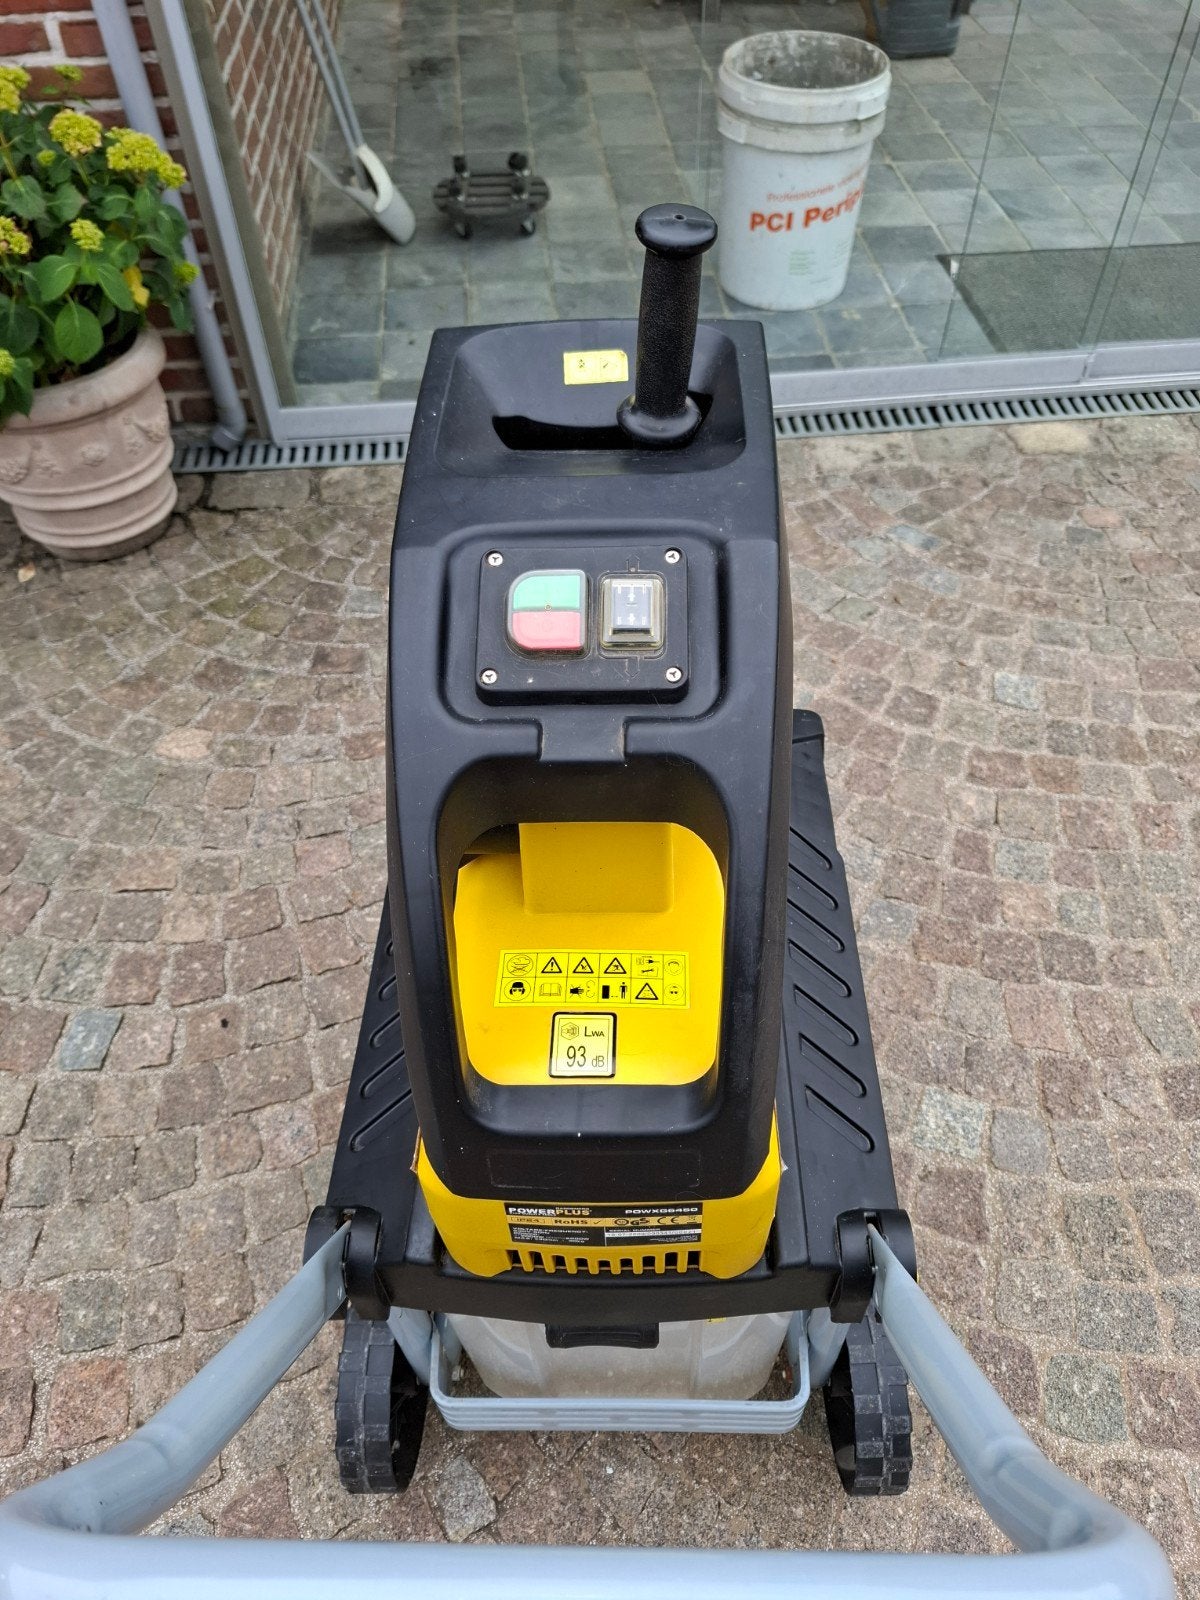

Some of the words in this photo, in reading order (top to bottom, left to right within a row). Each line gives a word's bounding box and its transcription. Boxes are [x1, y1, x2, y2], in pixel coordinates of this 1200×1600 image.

[750, 211, 794, 232] PCI
[566, 1045, 586, 1067] 93
[591, 1055, 605, 1067] dB
[657, 1216, 679, 1224] CE
